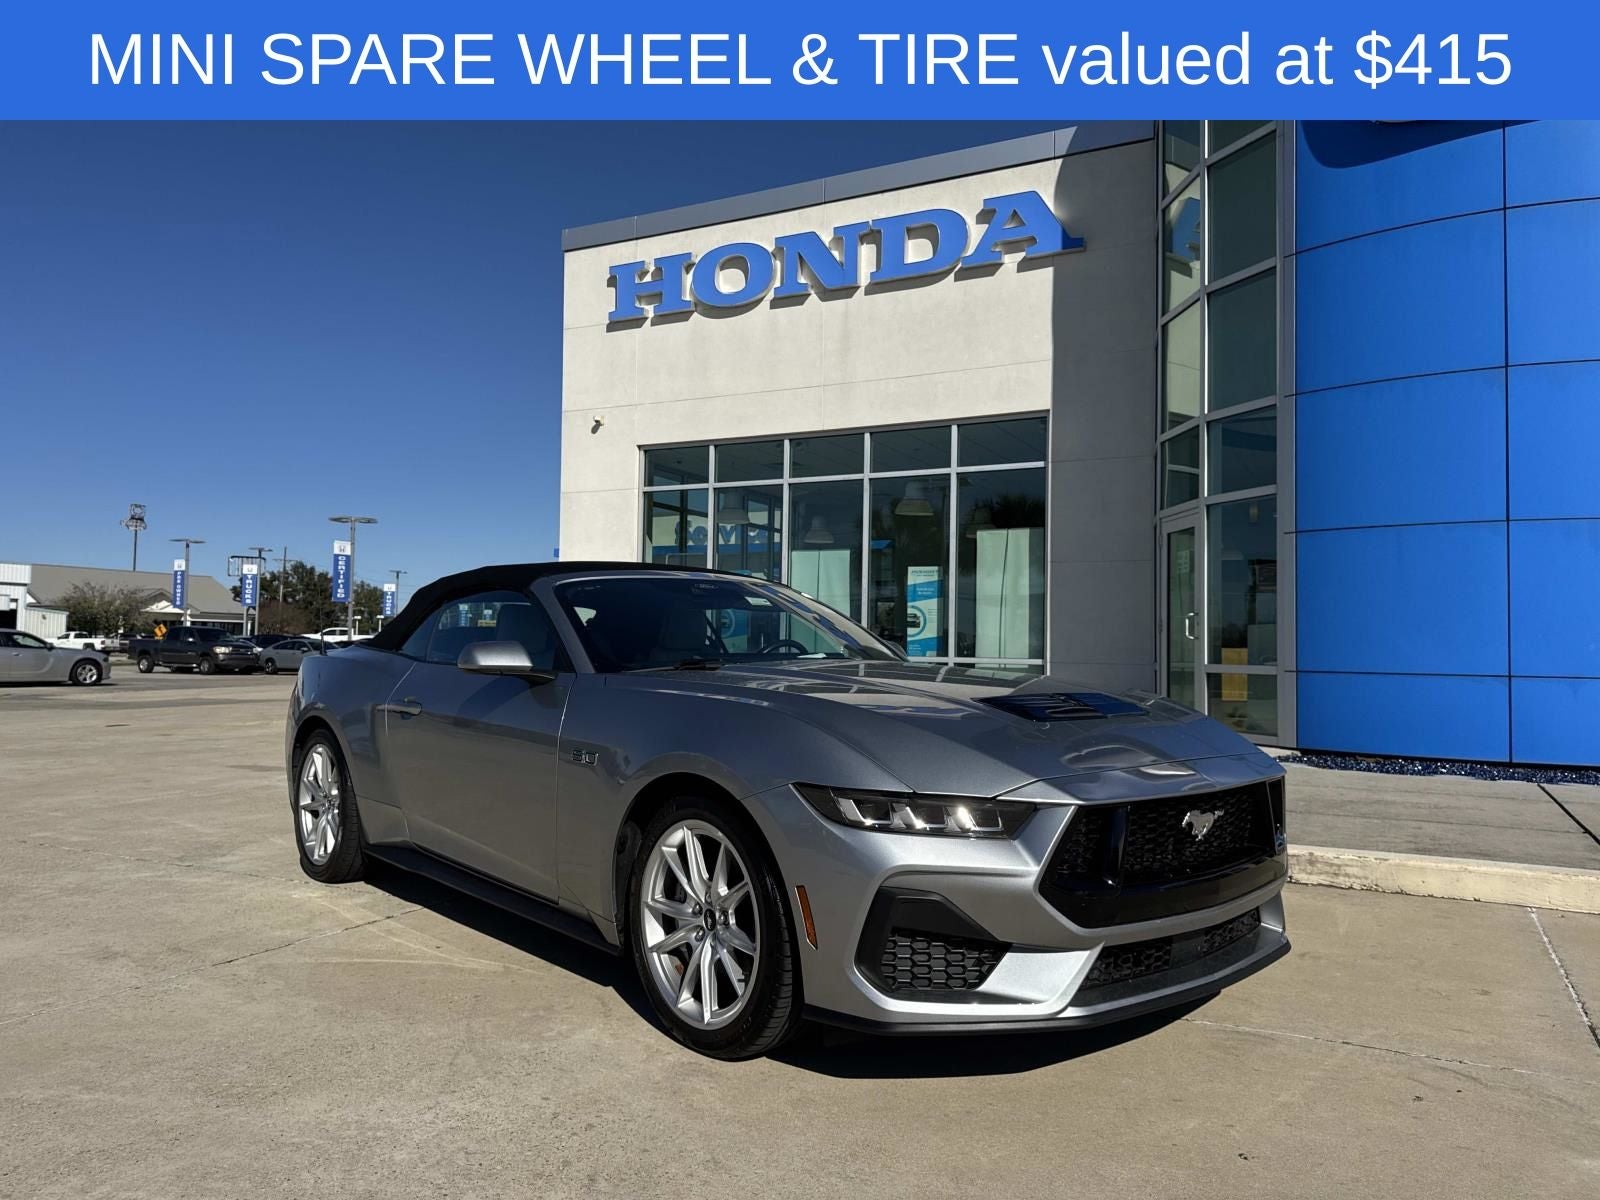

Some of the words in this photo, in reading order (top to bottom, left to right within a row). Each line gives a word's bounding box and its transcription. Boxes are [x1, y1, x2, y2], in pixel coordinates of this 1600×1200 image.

[609, 190, 1085, 323] HONDA
[244, 574, 253, 603] TRUCKS
[336, 556, 346, 598] CERTIFIED
